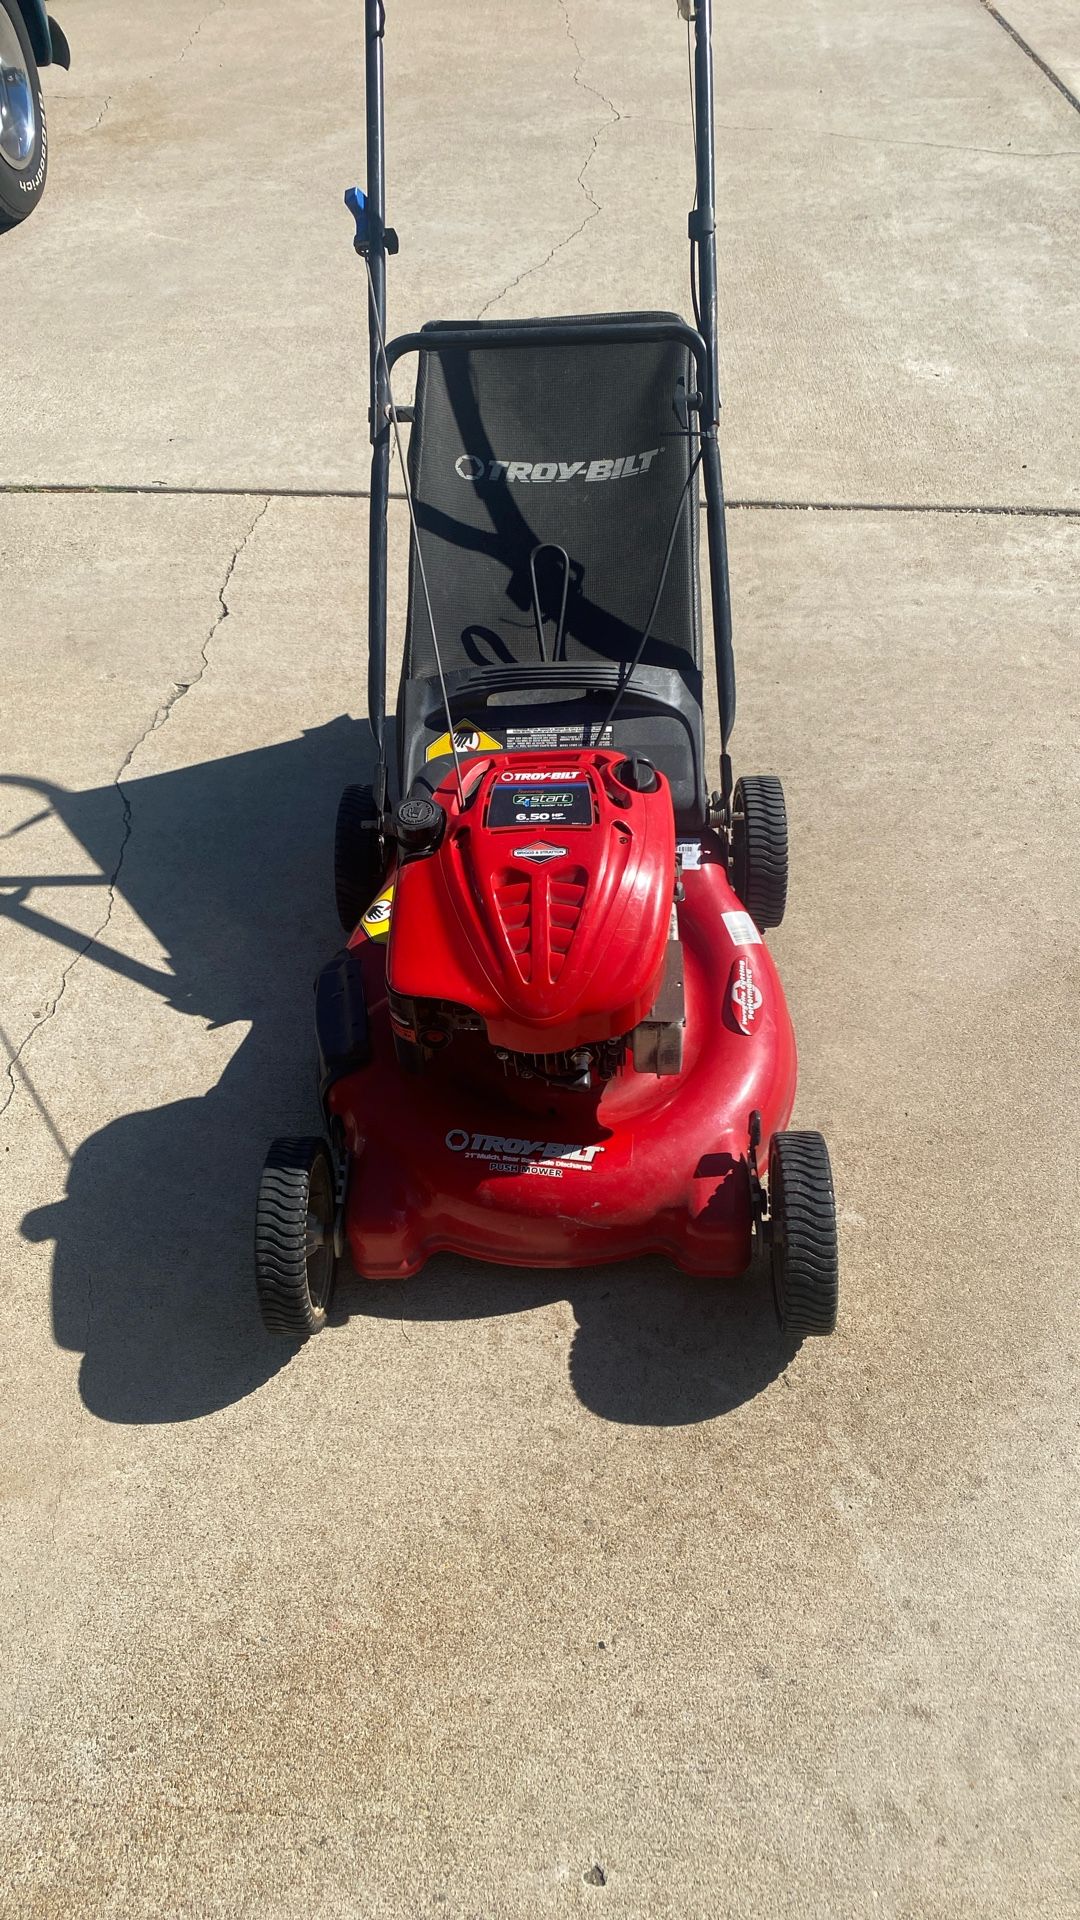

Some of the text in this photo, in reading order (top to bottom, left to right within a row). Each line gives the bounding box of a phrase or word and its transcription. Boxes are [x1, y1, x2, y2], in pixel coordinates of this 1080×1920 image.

[488, 448, 659, 483] TROY-BILT
[514, 771, 581, 780] TROY-BILT
[471, 1133, 601, 1162] TROY-BILT
[489, 1162, 563, 1178] PUSH MOWER
[555, 1161, 593, 1171] Discharge
